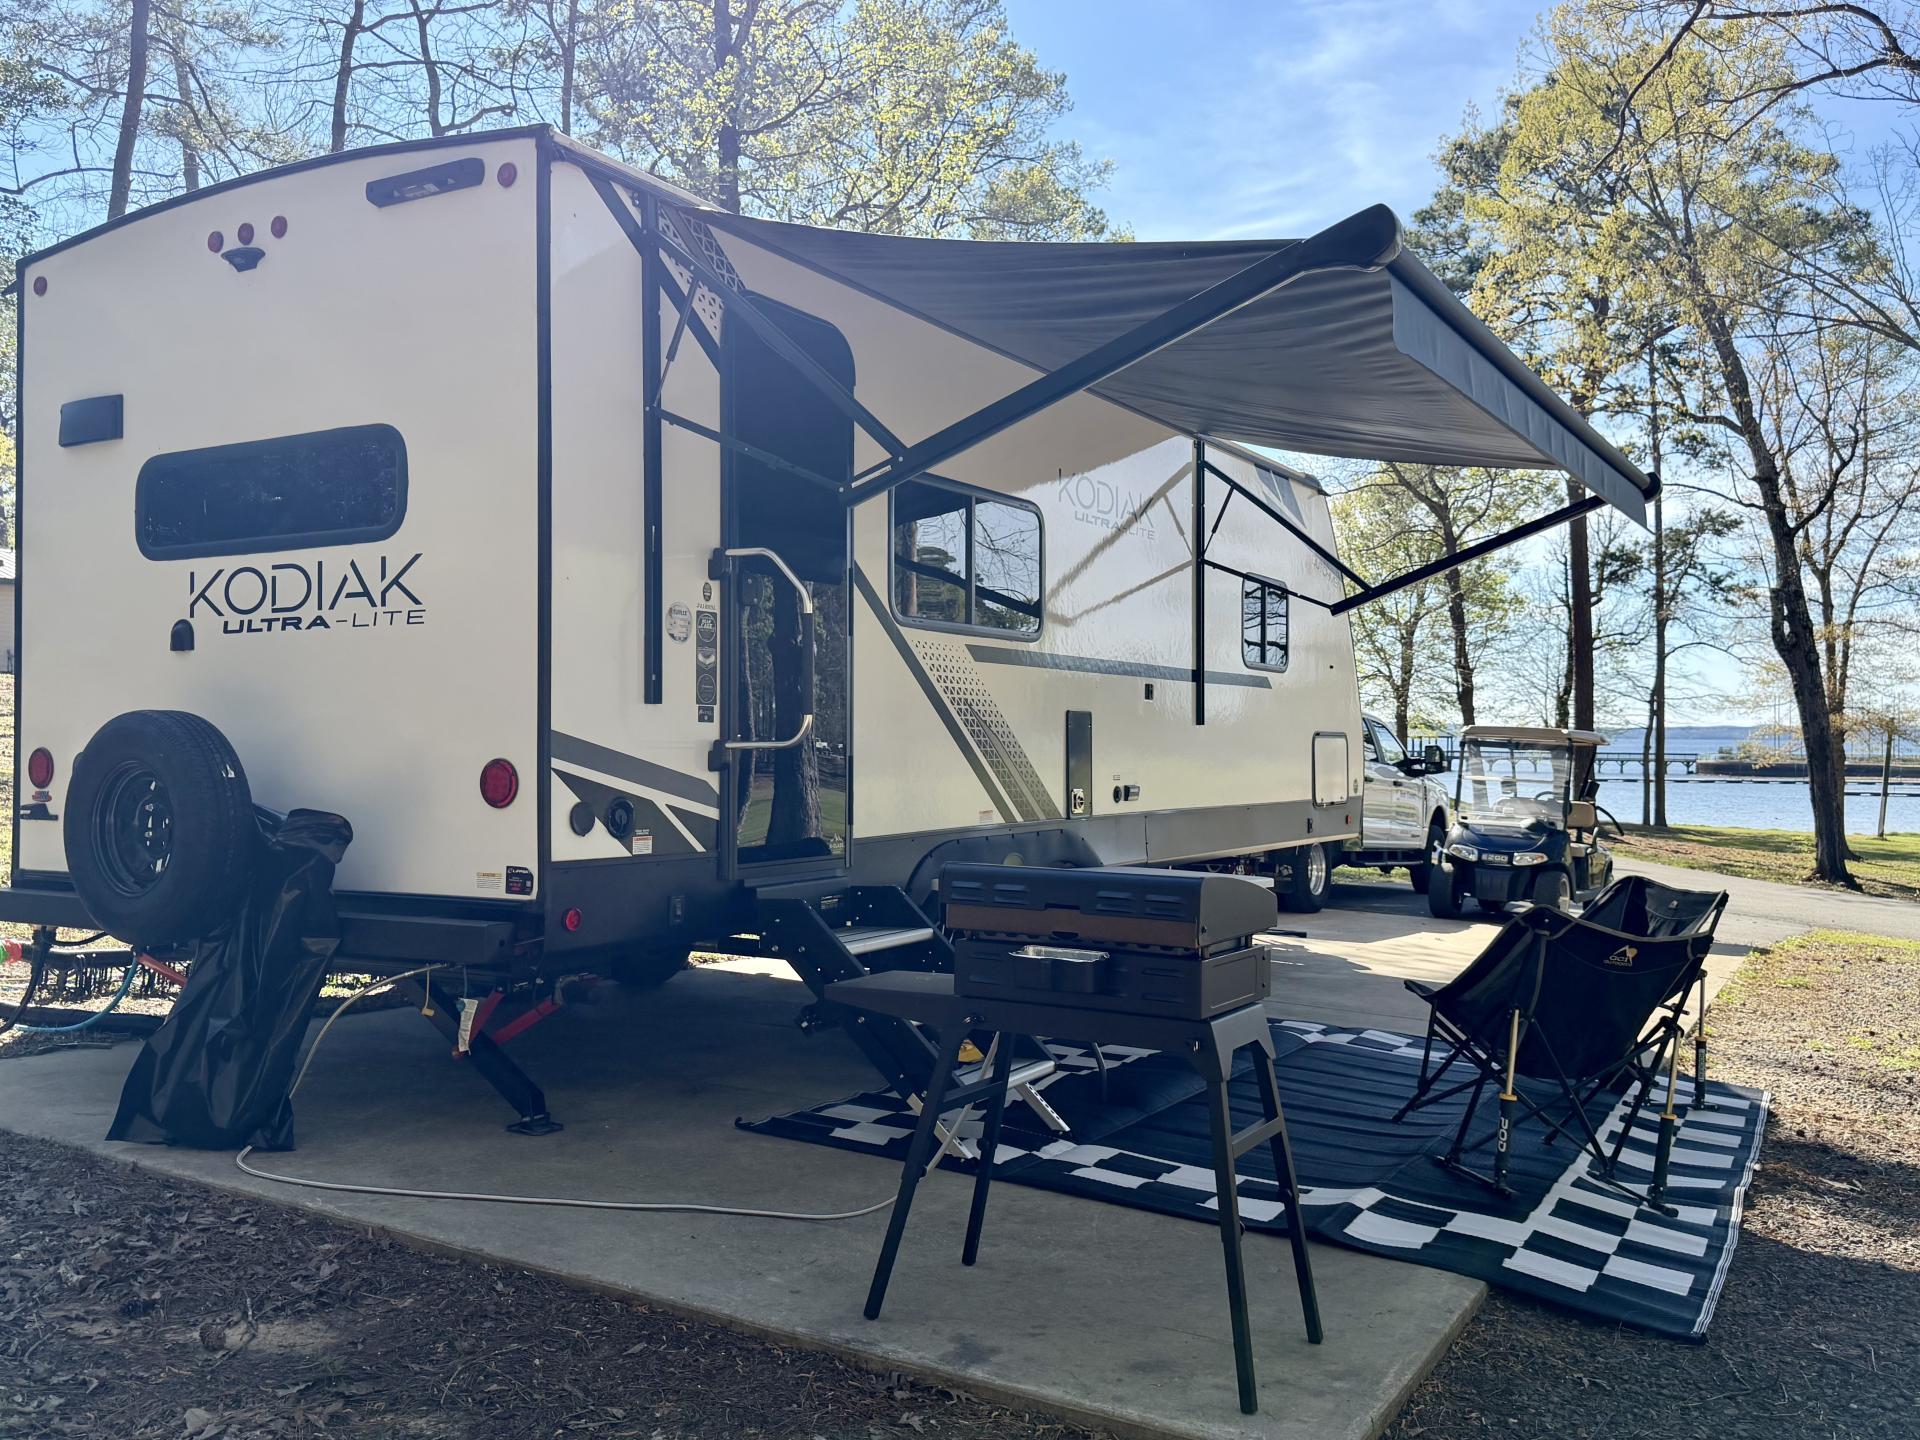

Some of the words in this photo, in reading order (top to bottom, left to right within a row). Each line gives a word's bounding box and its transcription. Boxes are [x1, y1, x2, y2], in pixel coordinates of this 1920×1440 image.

[1059, 467, 1154, 529] KODIAK
[1074, 510, 1155, 540] ULTRA-LITE
[190, 553, 423, 619] KODIAK
[223, 609, 426, 634] ULTRA-LITE
[1498, 1116, 1509, 1152] POD
